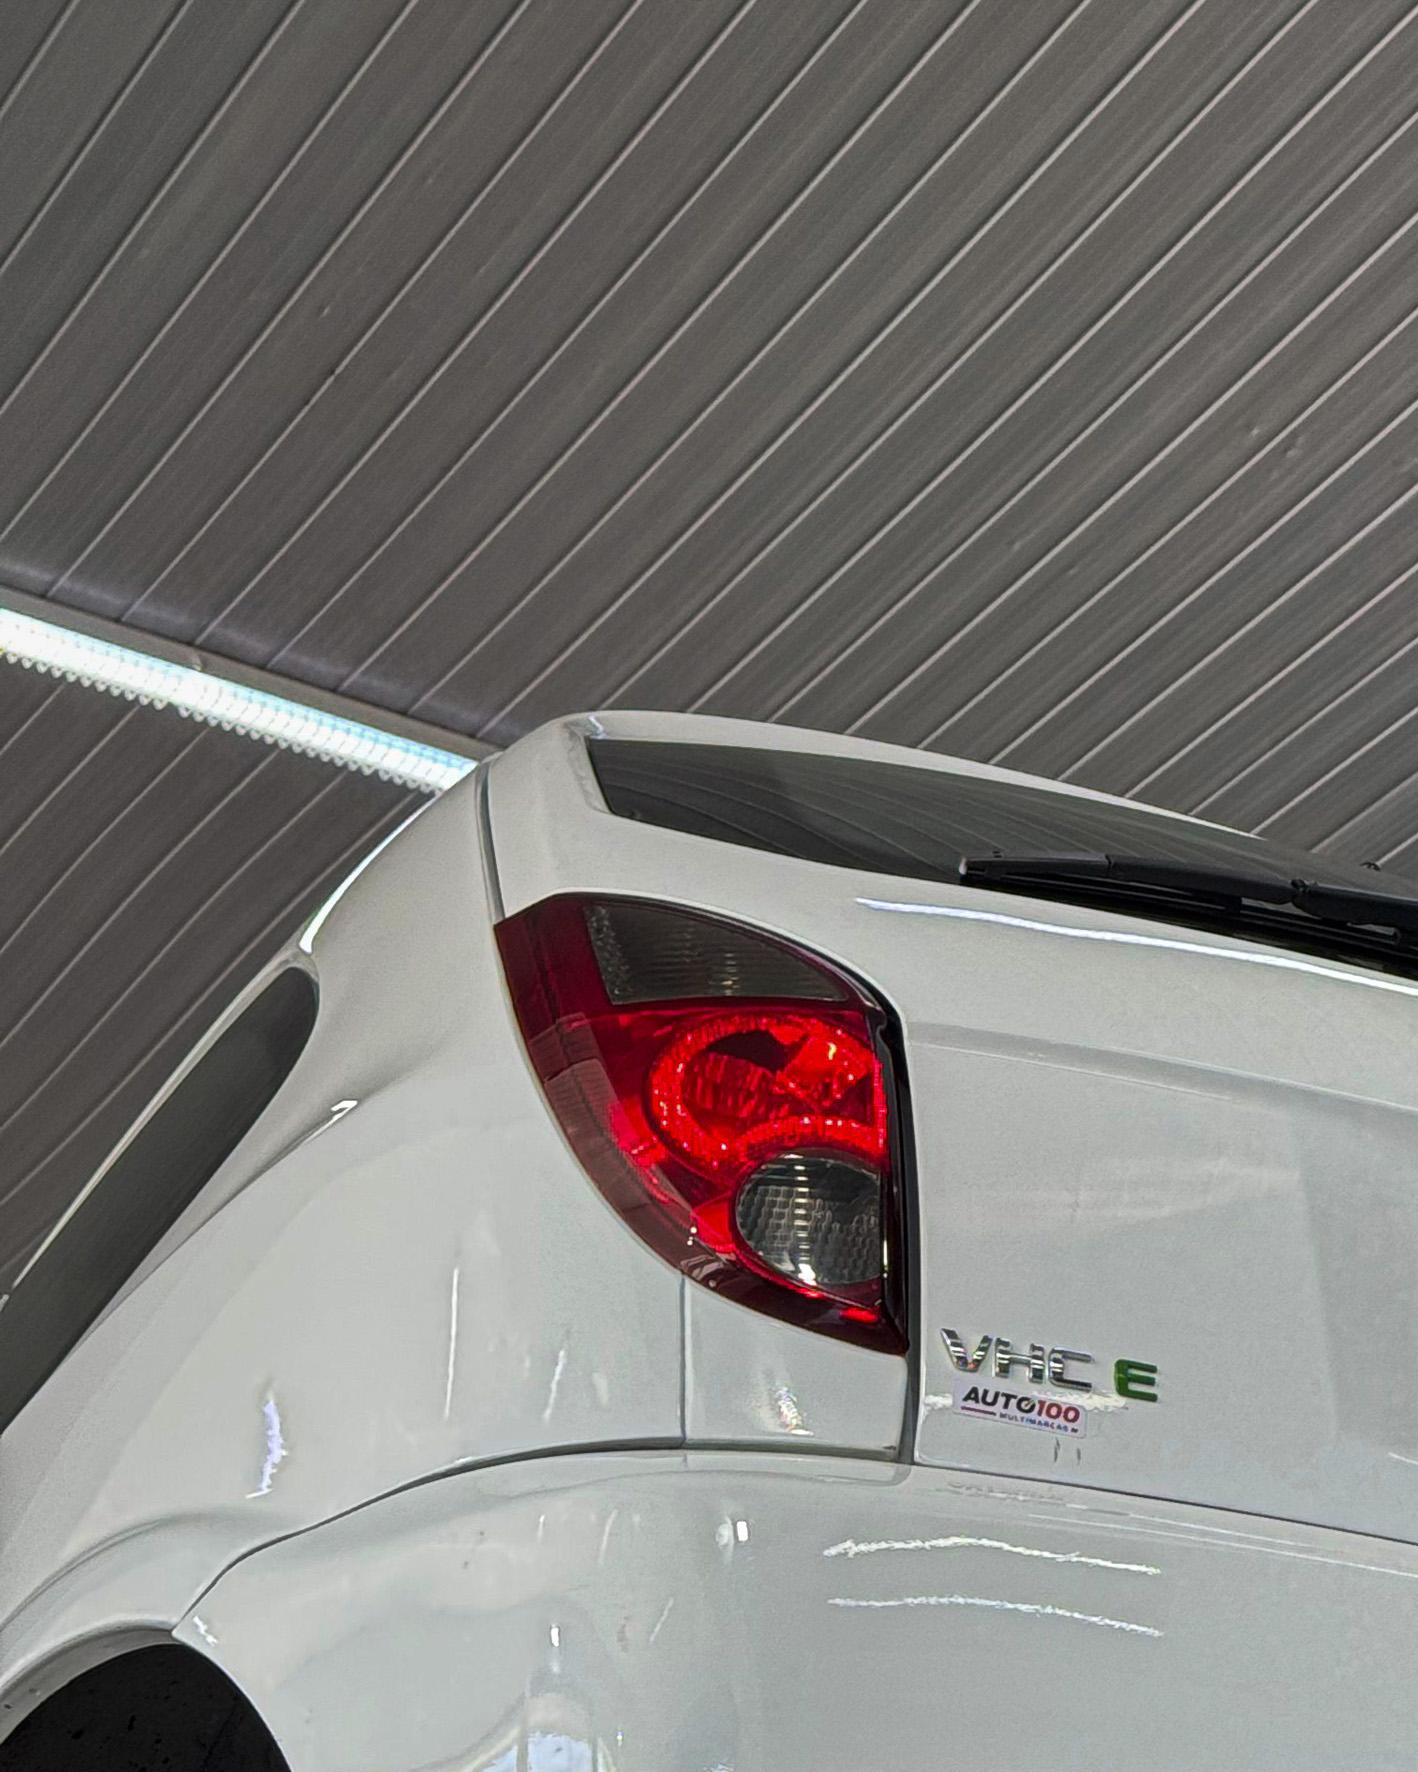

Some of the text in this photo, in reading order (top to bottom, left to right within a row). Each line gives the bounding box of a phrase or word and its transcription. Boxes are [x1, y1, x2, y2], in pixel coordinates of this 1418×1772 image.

[940, 1327, 1158, 1402] VHC E
[961, 1385, 1081, 1424] AUTO100
